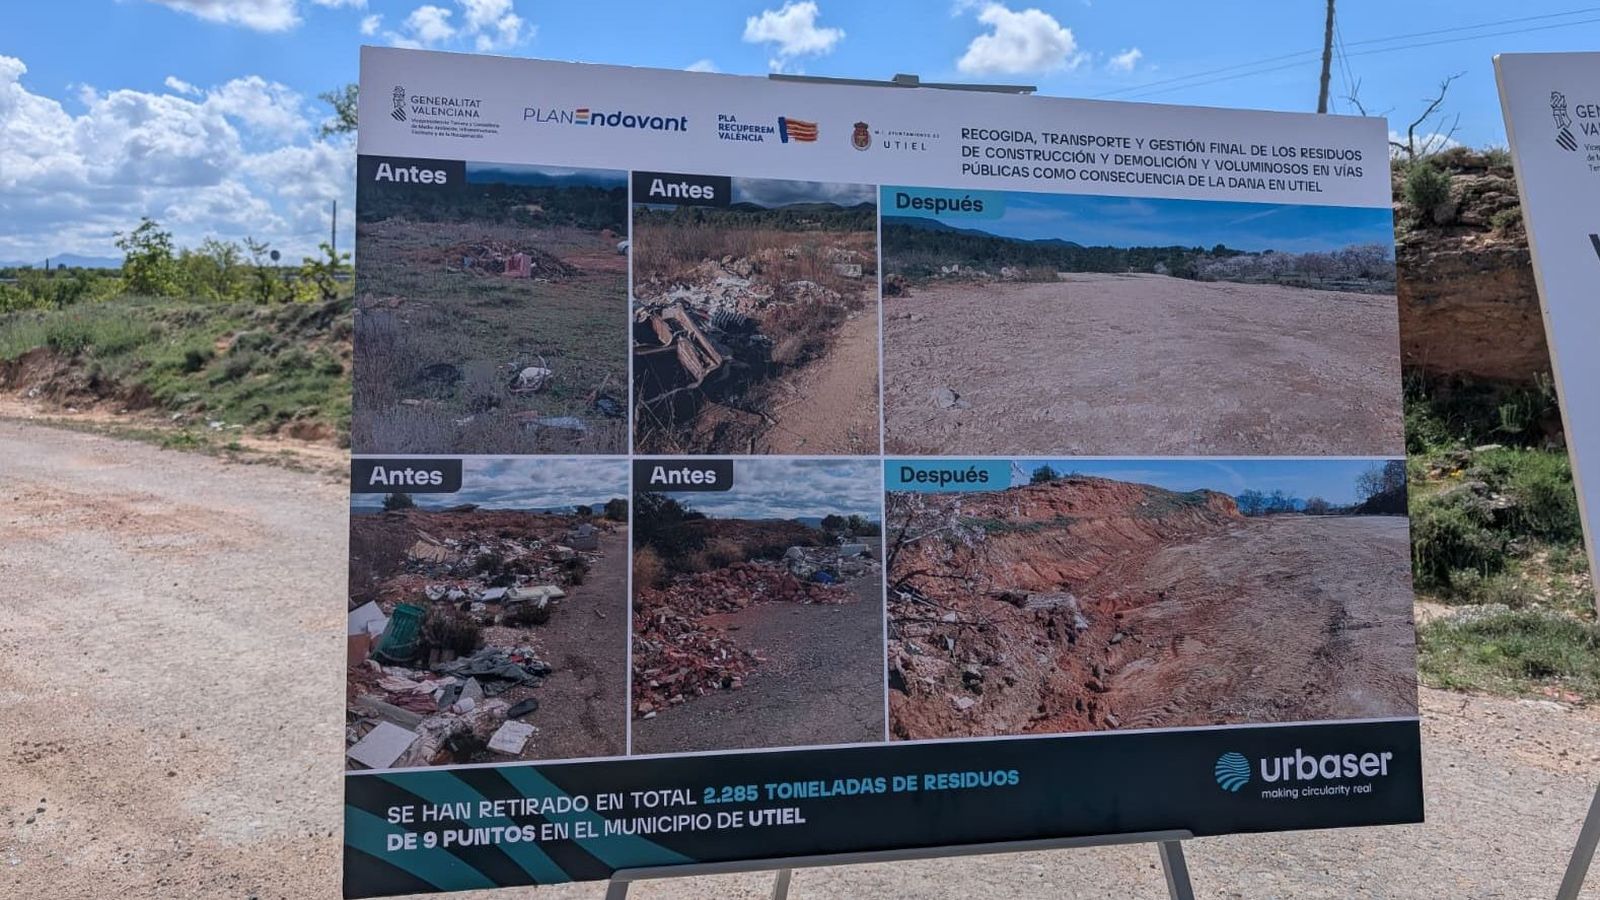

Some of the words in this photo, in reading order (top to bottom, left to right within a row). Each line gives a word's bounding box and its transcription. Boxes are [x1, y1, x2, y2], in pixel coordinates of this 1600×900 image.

[411, 95, 482, 108] GENERALITAT
[411, 106, 480, 118] VALENCIANA
[718, 114, 736, 122] PLA
[718, 123, 775, 134] RECUPEREM
[883, 140, 926, 151] UTIEL
[961, 127, 1037, 145] RECOGIDA,
[1042, 132, 1131, 149] TRANSPORTE
[1135, 138, 1144, 149] Y
[1149, 138, 1206, 153] GESTIÓN
[1210, 142, 1247, 155] FINAL
[1250, 144, 1268, 157] DE
[1272, 146, 1297, 158] LOS
[1300, 147, 1362, 161] RESIDUOS
[961, 145, 980, 158] DE
[985, 147, 1096, 164] CONSTRUCCIÓN
[1101, 153, 1110, 164] Y
[1114, 154, 1197, 169] DEMOLICIÓN
[1201, 159, 1210, 170] Y
[1215, 160, 1309, 175] VOLUMINOSOS
[1313, 164, 1330, 176] EN
[1334, 163, 1363, 177] VÍAS
[375, 162, 447, 185] Antes
[961, 161, 1030, 178] PÚBLICAS
[1033, 167, 1076, 180] COMO
[1079, 169, 1185, 186] CONSECUENCIA
[1188, 175, 1205, 187] DE
[1208, 176, 1225, 188] LA
[1228, 177, 1266, 190] DANA
[1268, 179, 1285, 191] EN
[1288, 180, 1323, 193] UTIEL
[648, 178, 715, 200] Antes
[896, 192, 984, 215] Después
[368, 465, 443, 486] Antes
[649, 465, 717, 485] Antes
[901, 465, 989, 487] Después
[1260, 748, 1393, 782] urbaser
[387, 805, 415, 824] SE
[422, 801, 472, 822] HAN
[478, 795, 589, 819] RETIRADO
[596, 792, 623, 811] EN
[631, 788, 697, 809] TOTAL
[703, 785, 758, 804] 2.285
[765, 776, 887, 800] TONELADAS
[893, 775, 918, 792] DE
[924, 769, 1020, 790] RESIDUOS
[1261, 787, 1299, 799] making
[1302, 784, 1350, 797] circularity
[1353, 783, 1372, 794] real
[387, 831, 417, 852] DE
[423, 830, 438, 849] 9
[443, 824, 536, 848] PUNTOS
[541, 822, 569, 841] EN
[575, 821, 599, 839] EL
[604, 813, 711, 837] MUNICIPIO
[717, 811, 743, 829] DE
[749, 807, 806, 827] UTIEL
